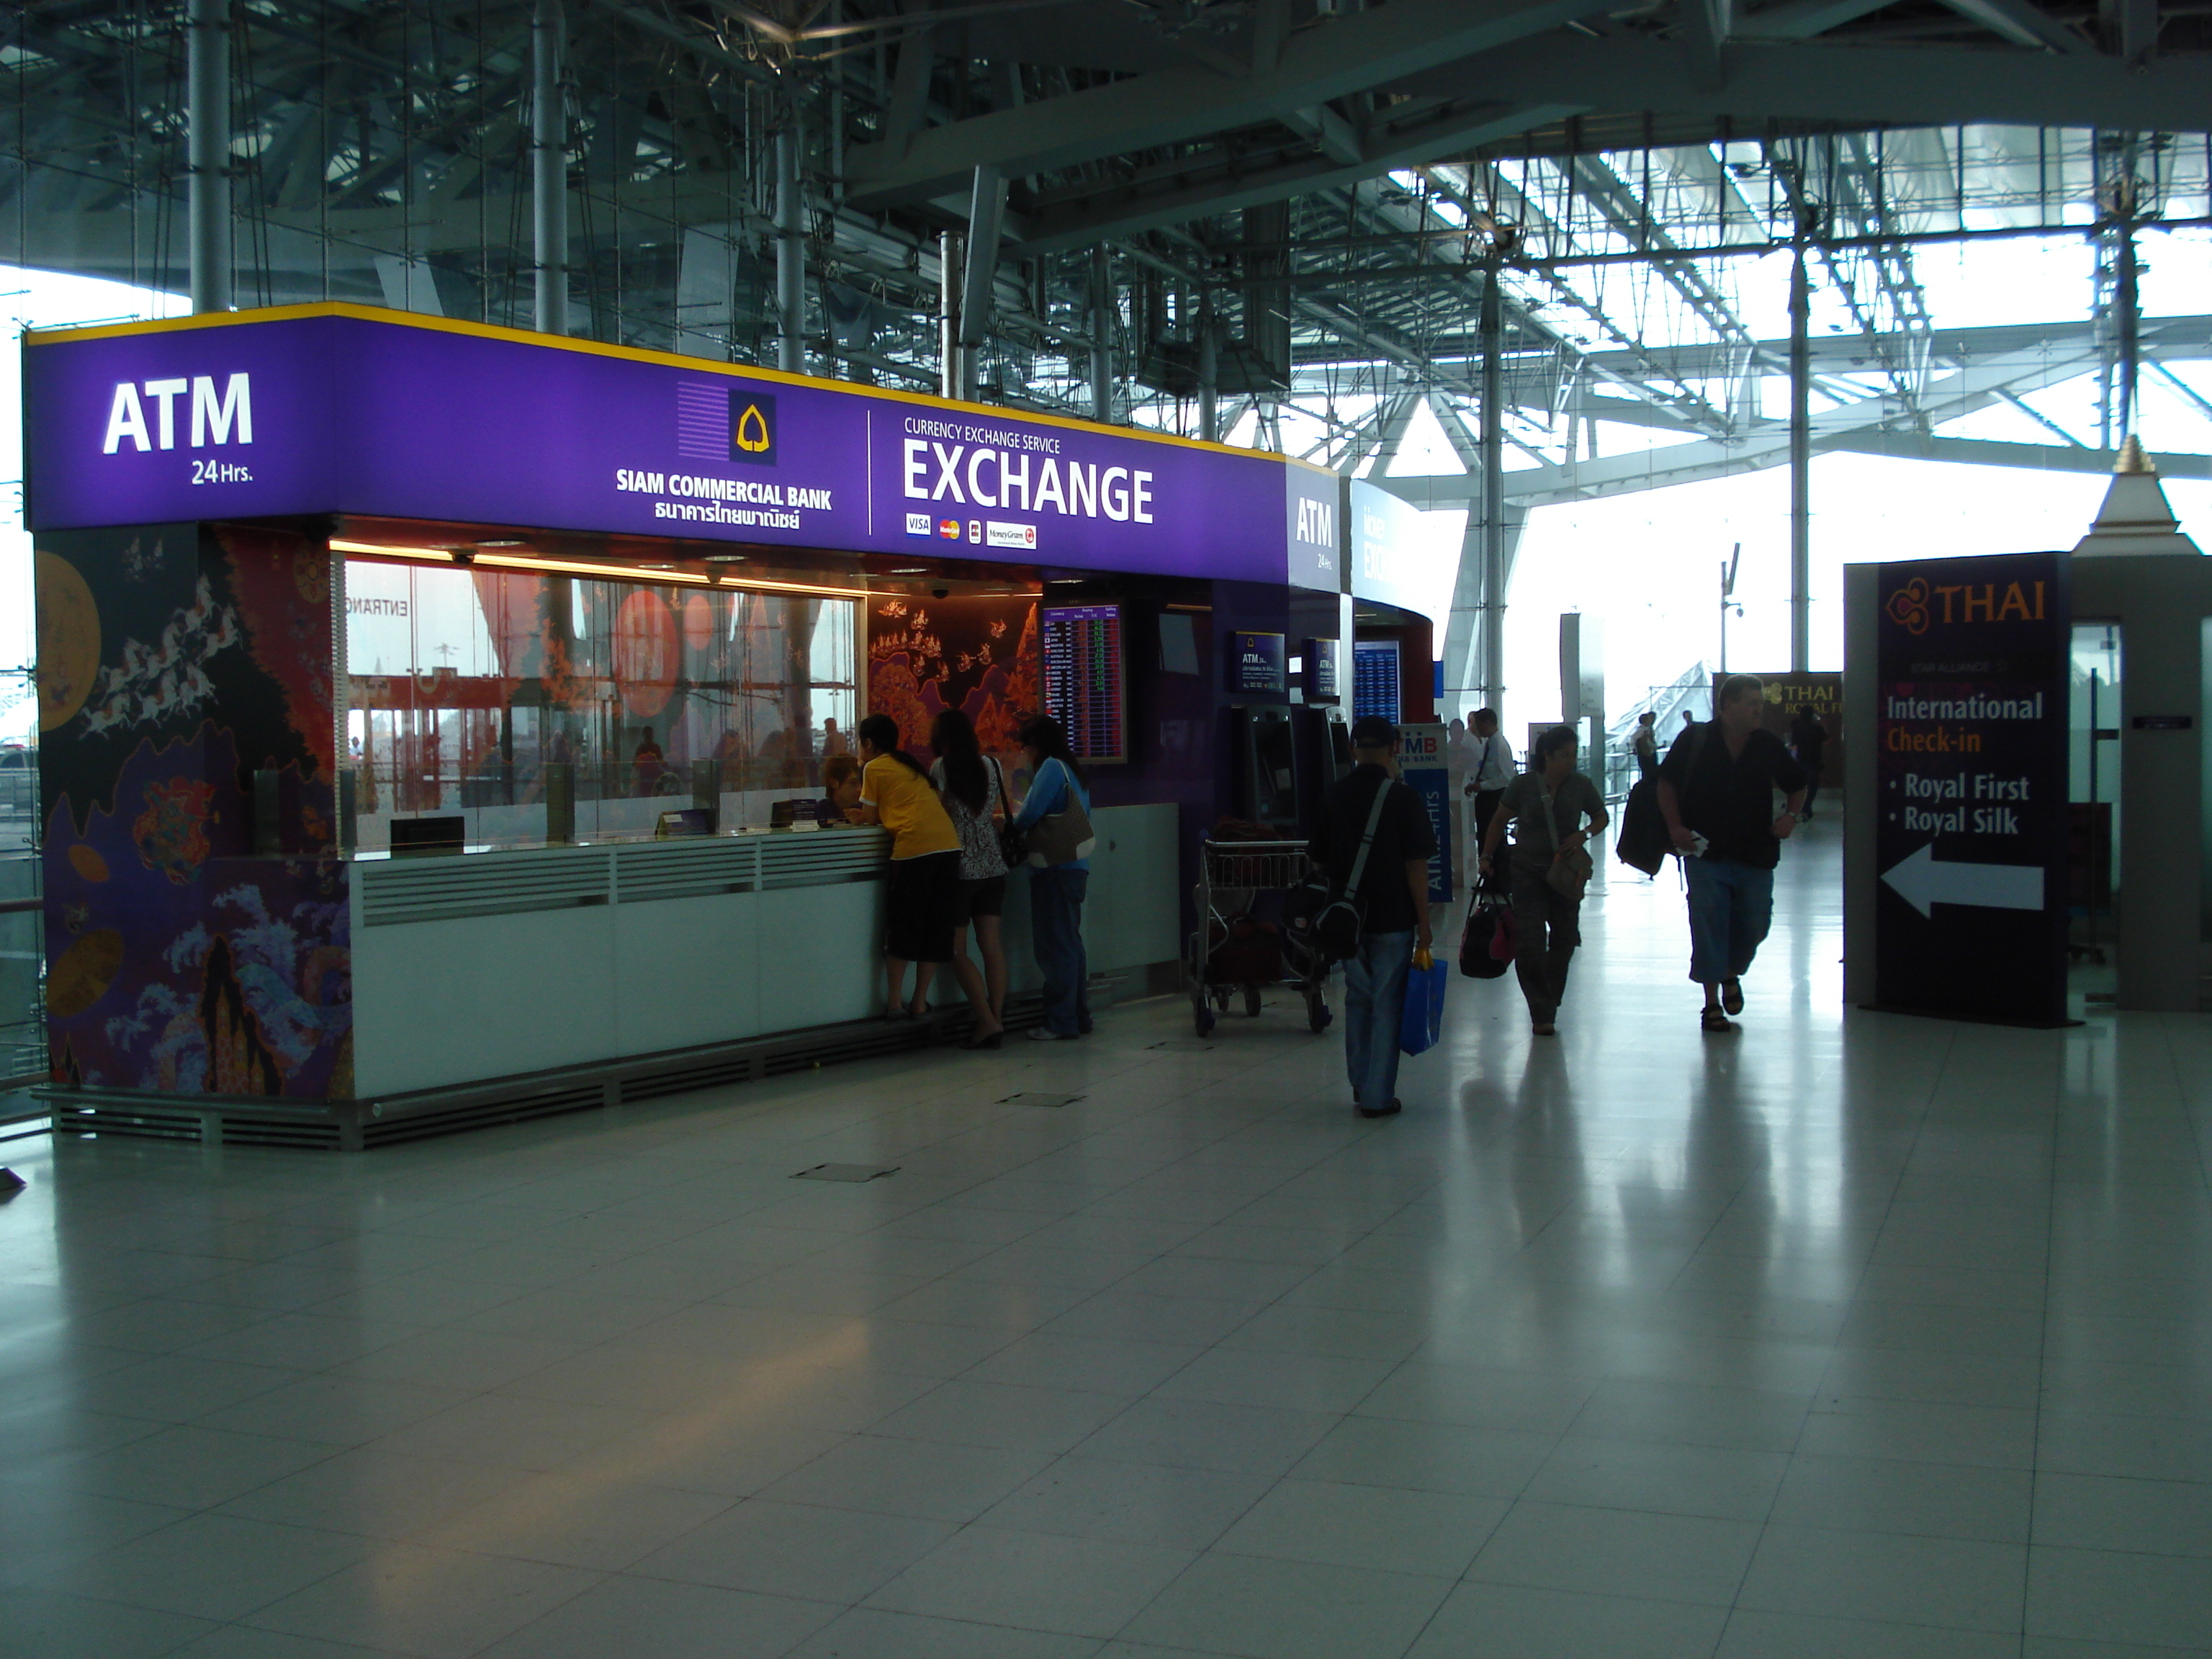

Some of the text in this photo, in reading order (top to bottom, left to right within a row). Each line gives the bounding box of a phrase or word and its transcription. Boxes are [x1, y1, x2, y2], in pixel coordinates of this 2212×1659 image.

[102, 372, 253, 454] ATM
[904, 416, 1060, 454] CURRENCY EXCHANGE SERVICE
[616, 468, 832, 511] SIAM COMMERCIAL BANK
[904, 438, 1154, 524] EXCHANGE
[655, 500, 800, 530] ธนาคารไทยพาณิชย์
[909, 517, 929, 530] VISA
[1296, 497, 1333, 548] ATM
[1933, 580, 2046, 624] THAI
[1243, 654, 1258, 664] ATM
[1784, 685, 1834, 701] THAI
[1784, 702, 1829, 714] ROAL
[1887, 693, 2042, 720] International
[1887, 727, 1981, 752] Check-in
[1905, 773, 2029, 803] Royal First
[1905, 806, 2019, 836] Royal Silk
